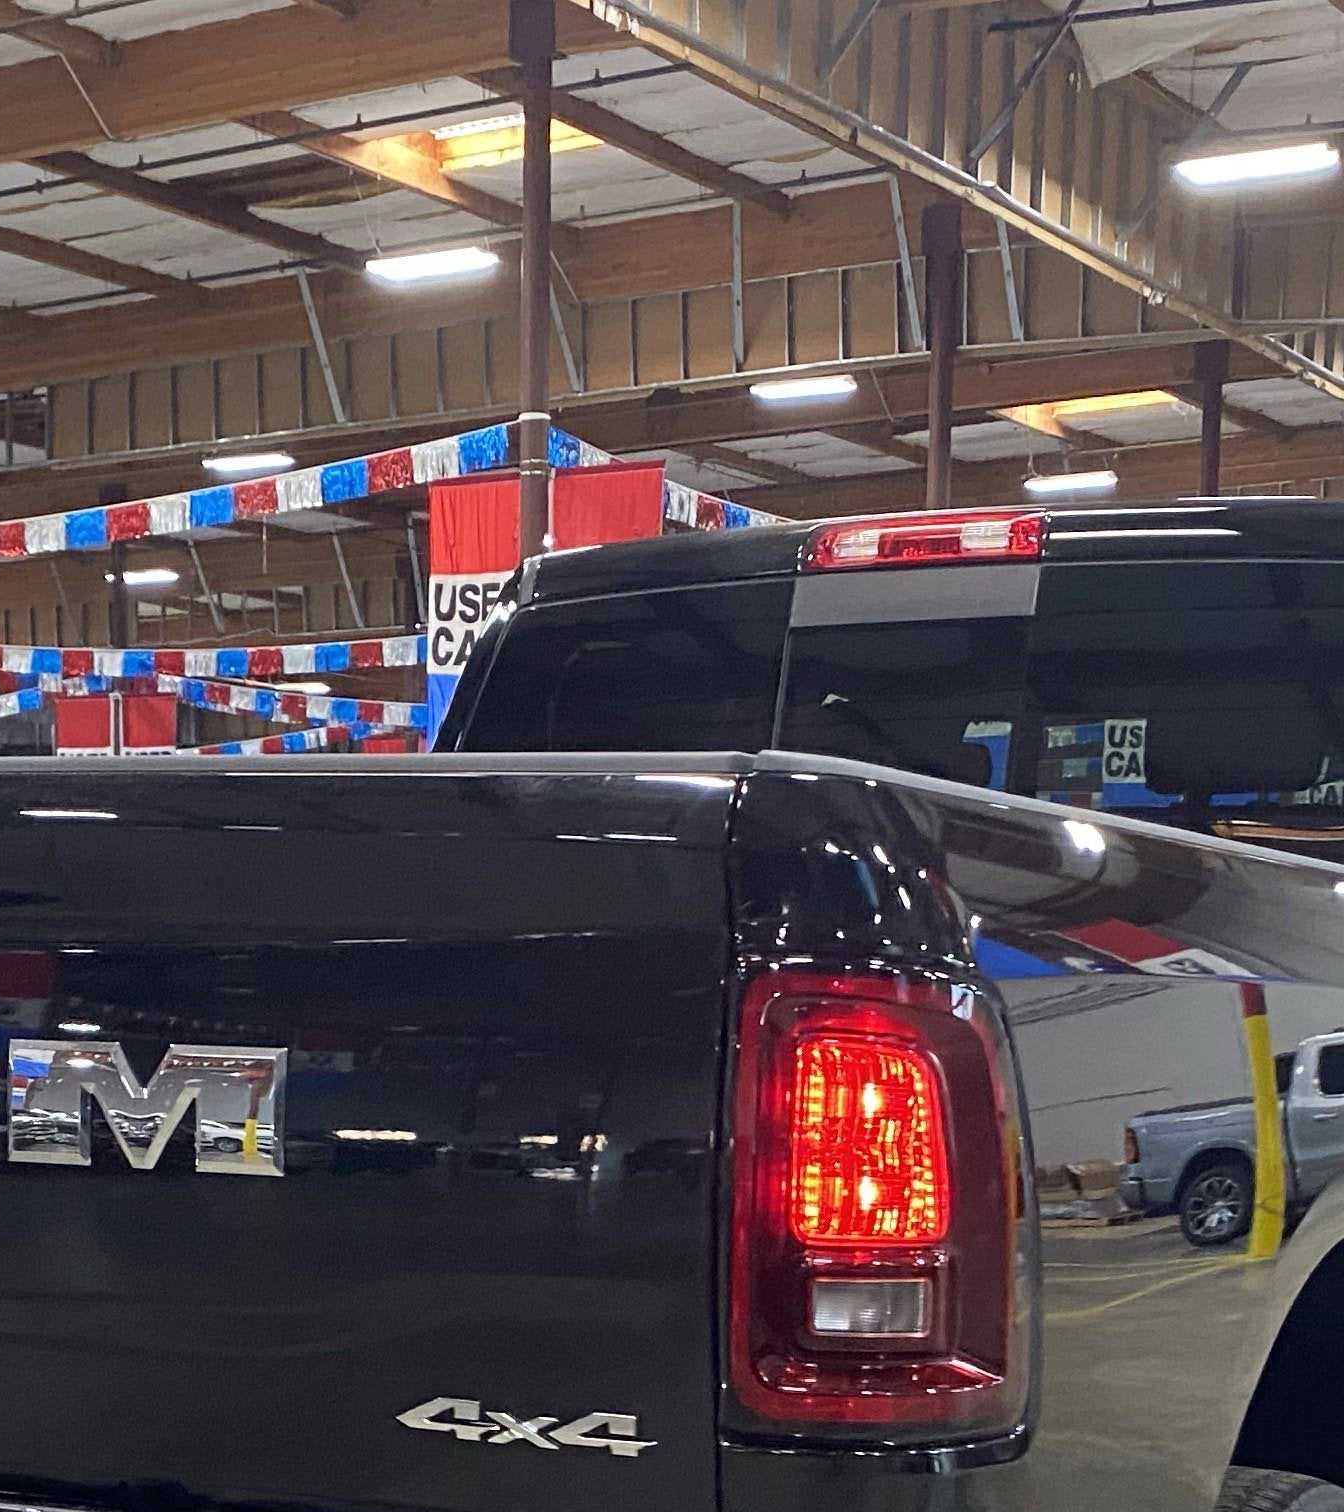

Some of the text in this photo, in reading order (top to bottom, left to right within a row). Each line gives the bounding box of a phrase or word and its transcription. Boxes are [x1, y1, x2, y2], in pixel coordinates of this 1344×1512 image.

[434, 582, 501, 623] USE
[432, 626, 476, 666] CA
[1108, 725, 1143, 748] US
[1106, 751, 1142, 777] CA
[396, 1397, 658, 1457] 4x4
